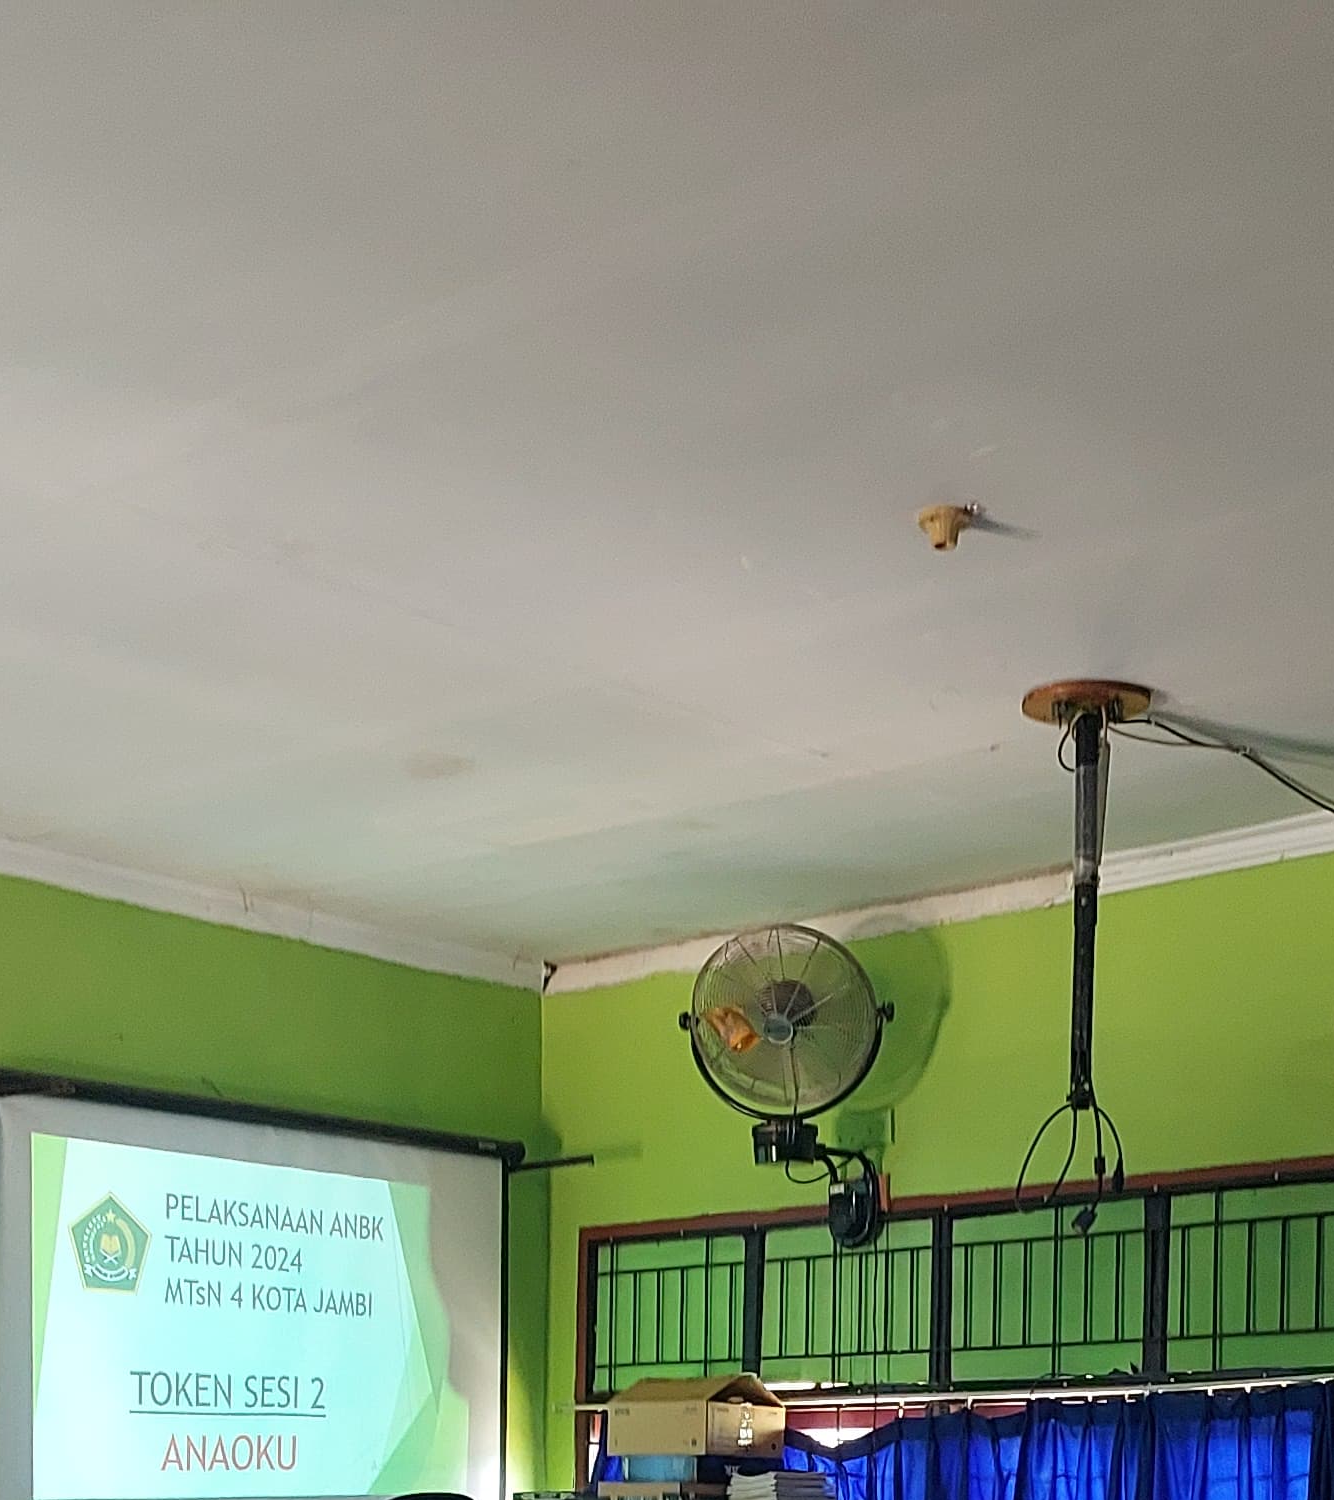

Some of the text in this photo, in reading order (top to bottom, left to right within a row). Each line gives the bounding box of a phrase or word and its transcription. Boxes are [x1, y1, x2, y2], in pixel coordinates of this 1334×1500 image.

[165, 1192, 385, 1242] PELAKSANAAN ANBK
[164, 1235, 303, 1273] TAHUN 2024
[165, 1277, 373, 1319] MTsN 4 KOTA JAMBI
[130, 1371, 325, 1410] TOKEN SESI 2
[161, 1433, 297, 1472] ANAOKU
